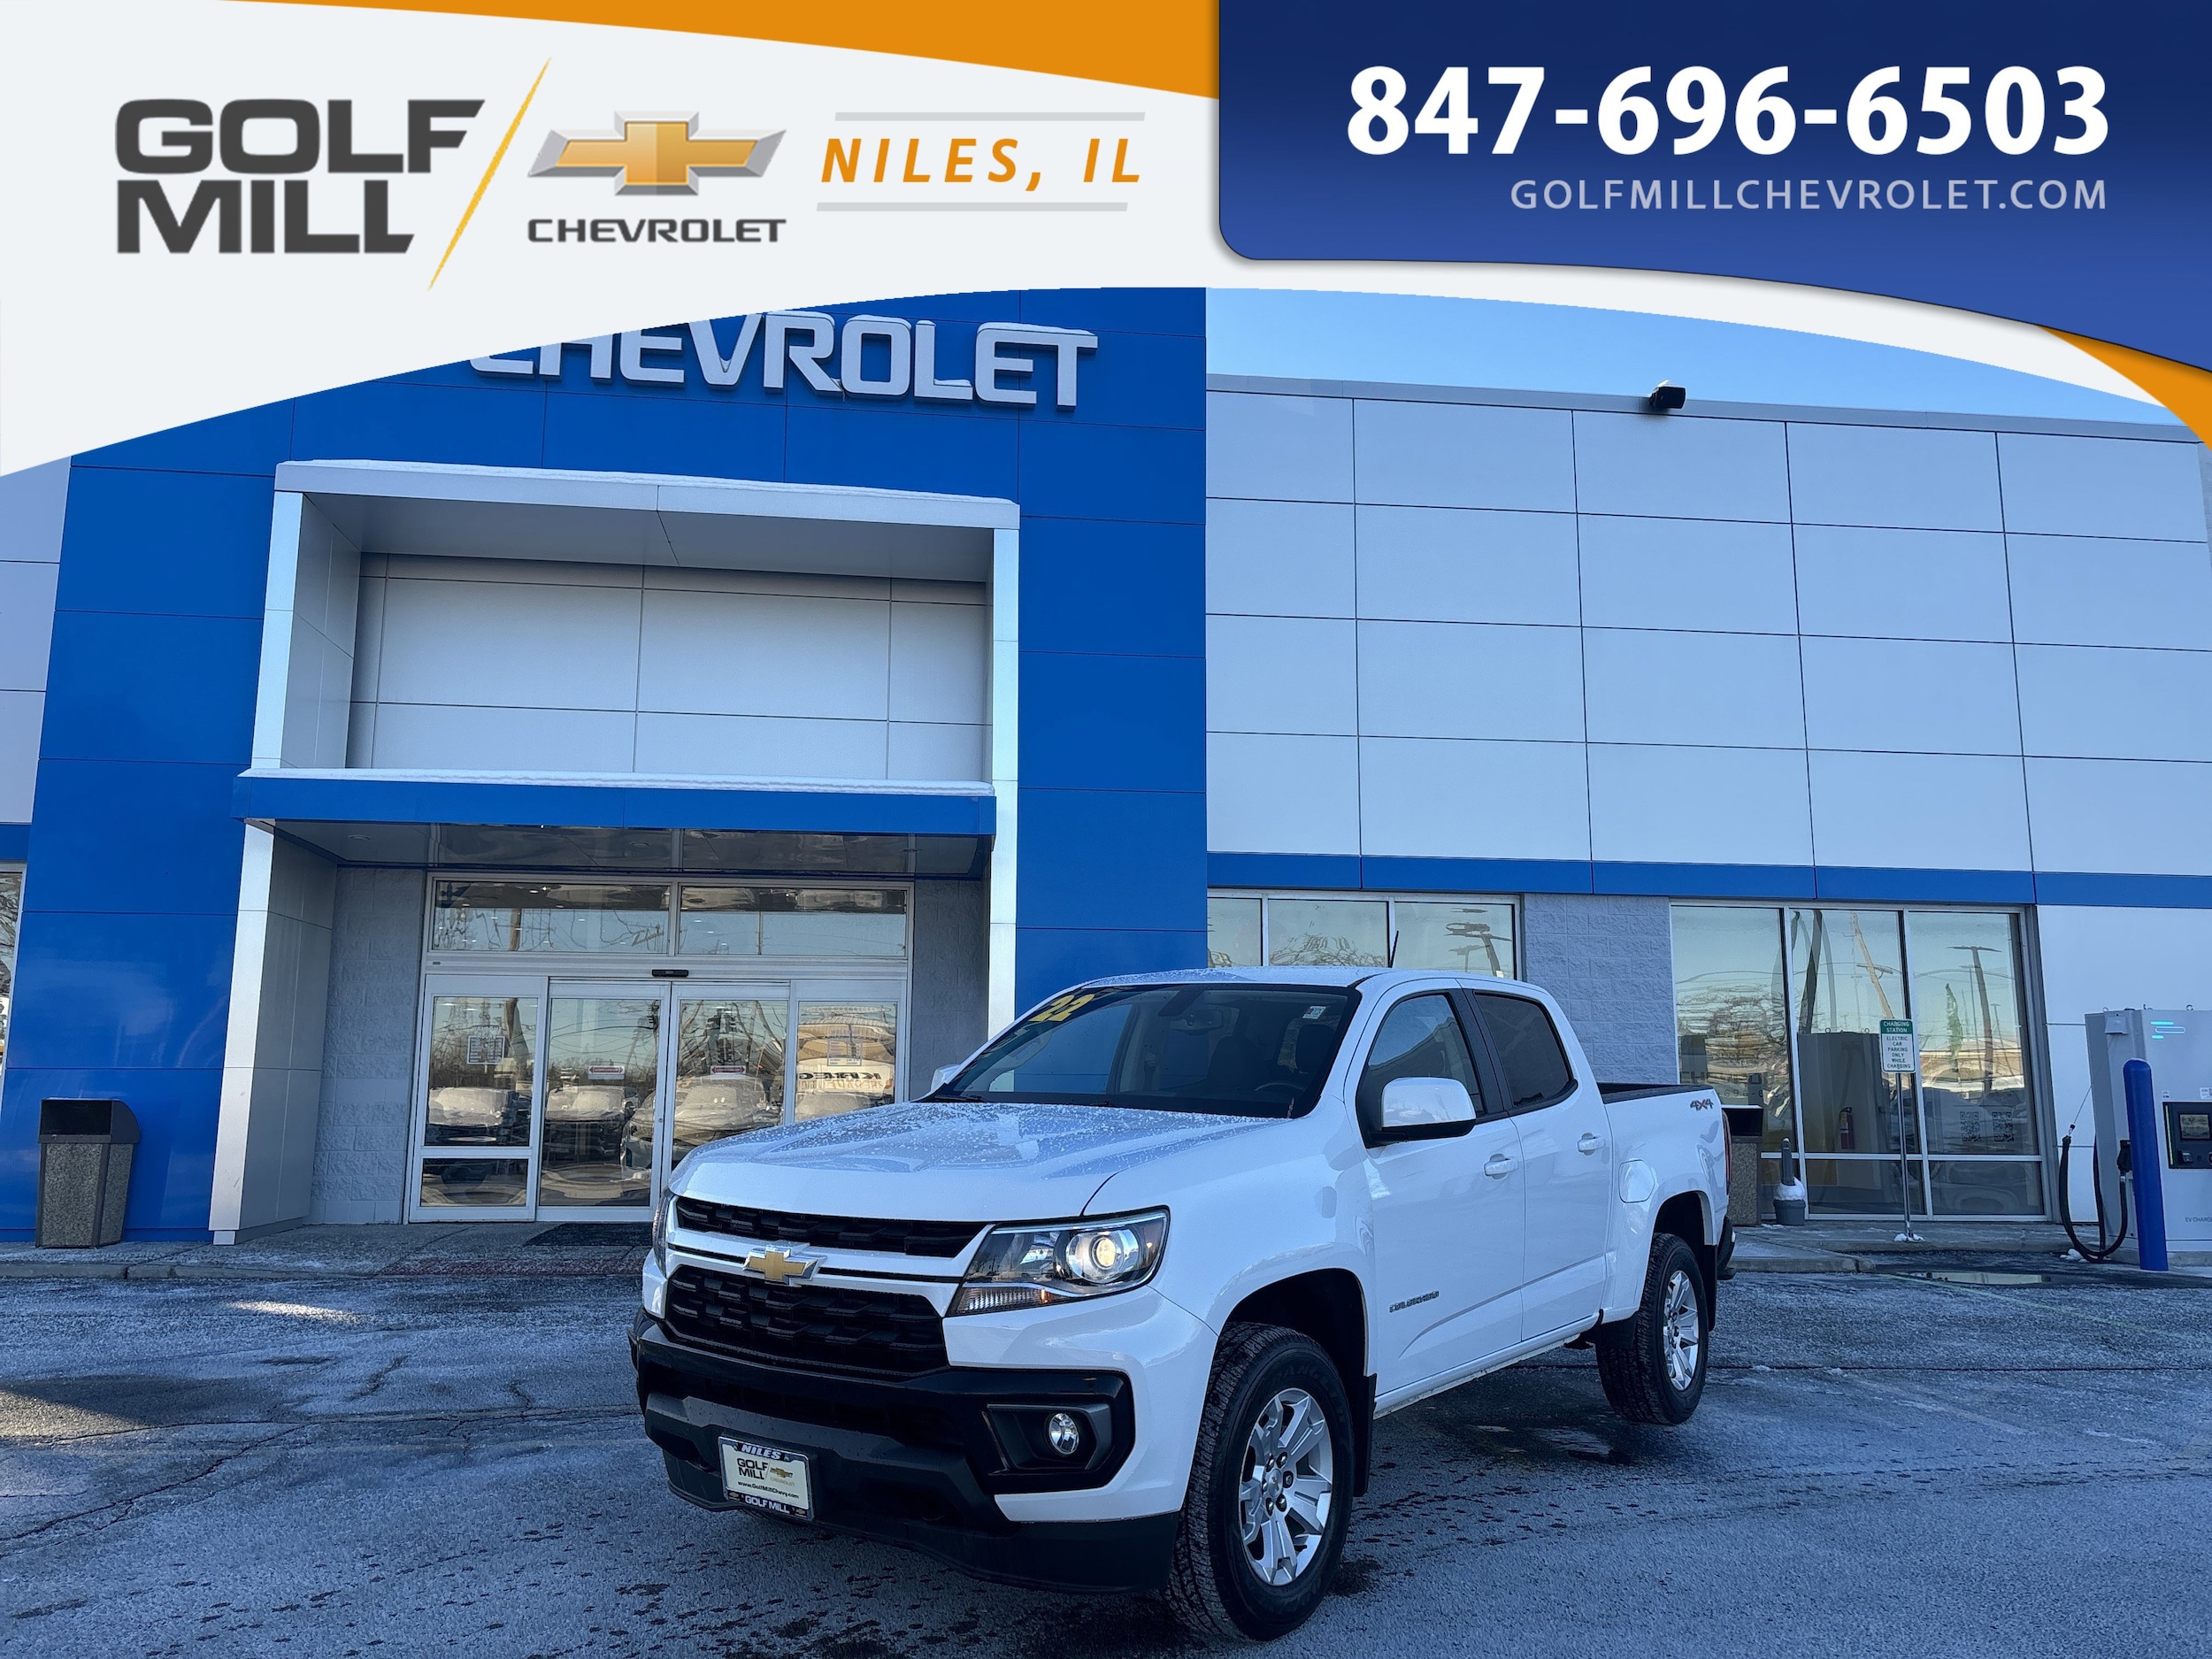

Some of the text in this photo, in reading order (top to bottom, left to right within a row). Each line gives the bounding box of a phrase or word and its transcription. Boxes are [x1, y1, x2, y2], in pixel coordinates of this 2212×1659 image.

[741, 1444, 781, 1460] NILES
[737, 1458, 768, 1471] GOLF
[739, 1467, 764, 1479] MILL
[745, 1495, 790, 1514] GOLF MILL
